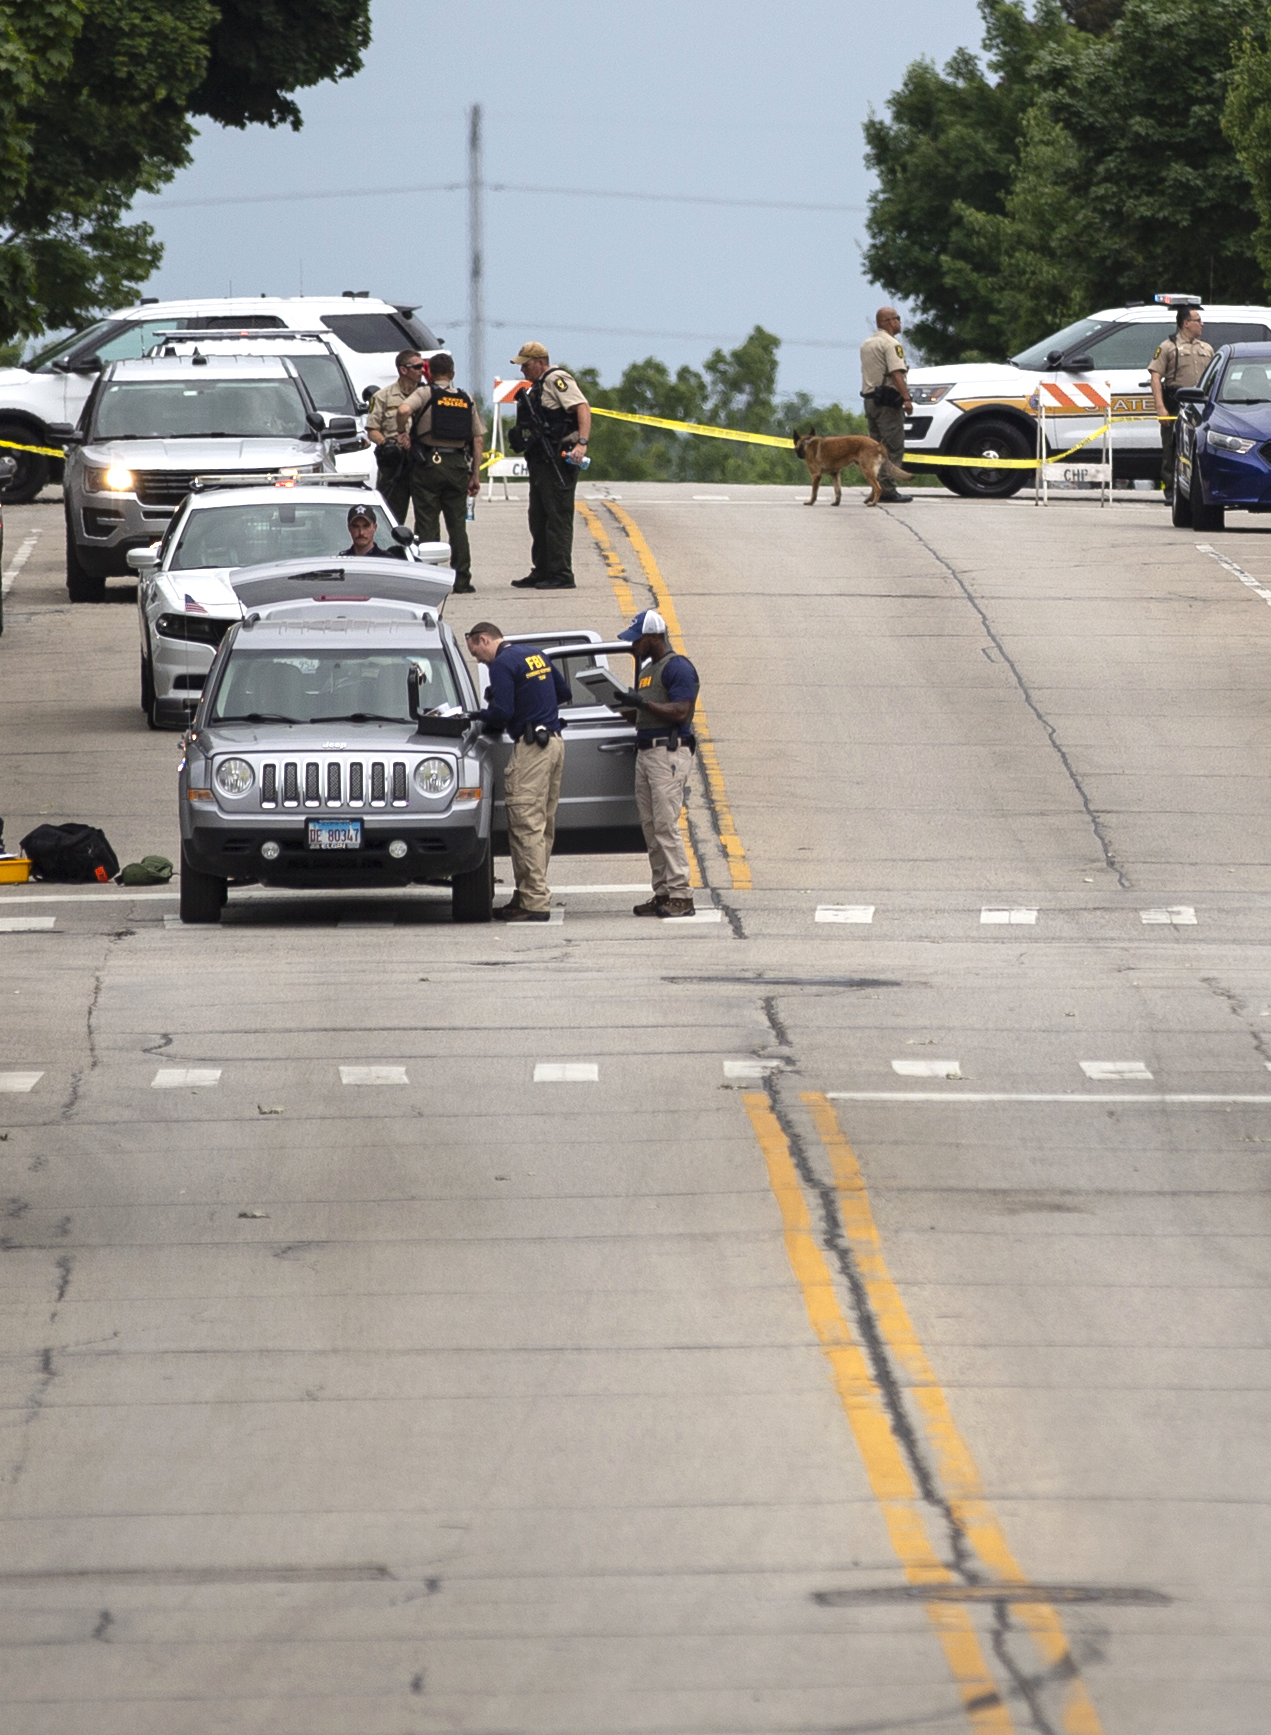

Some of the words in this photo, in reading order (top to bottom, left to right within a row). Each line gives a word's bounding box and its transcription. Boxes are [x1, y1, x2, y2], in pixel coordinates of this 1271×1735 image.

[512, 463, 529, 476] CH
[1064, 469, 1088, 481] CHP
[525, 654, 546, 671] FBI
[639, 676, 652, 689] FBI
[322, 742, 347, 750] Jeep
[310, 829, 322, 842] DE
[328, 828, 359, 842] 80347
